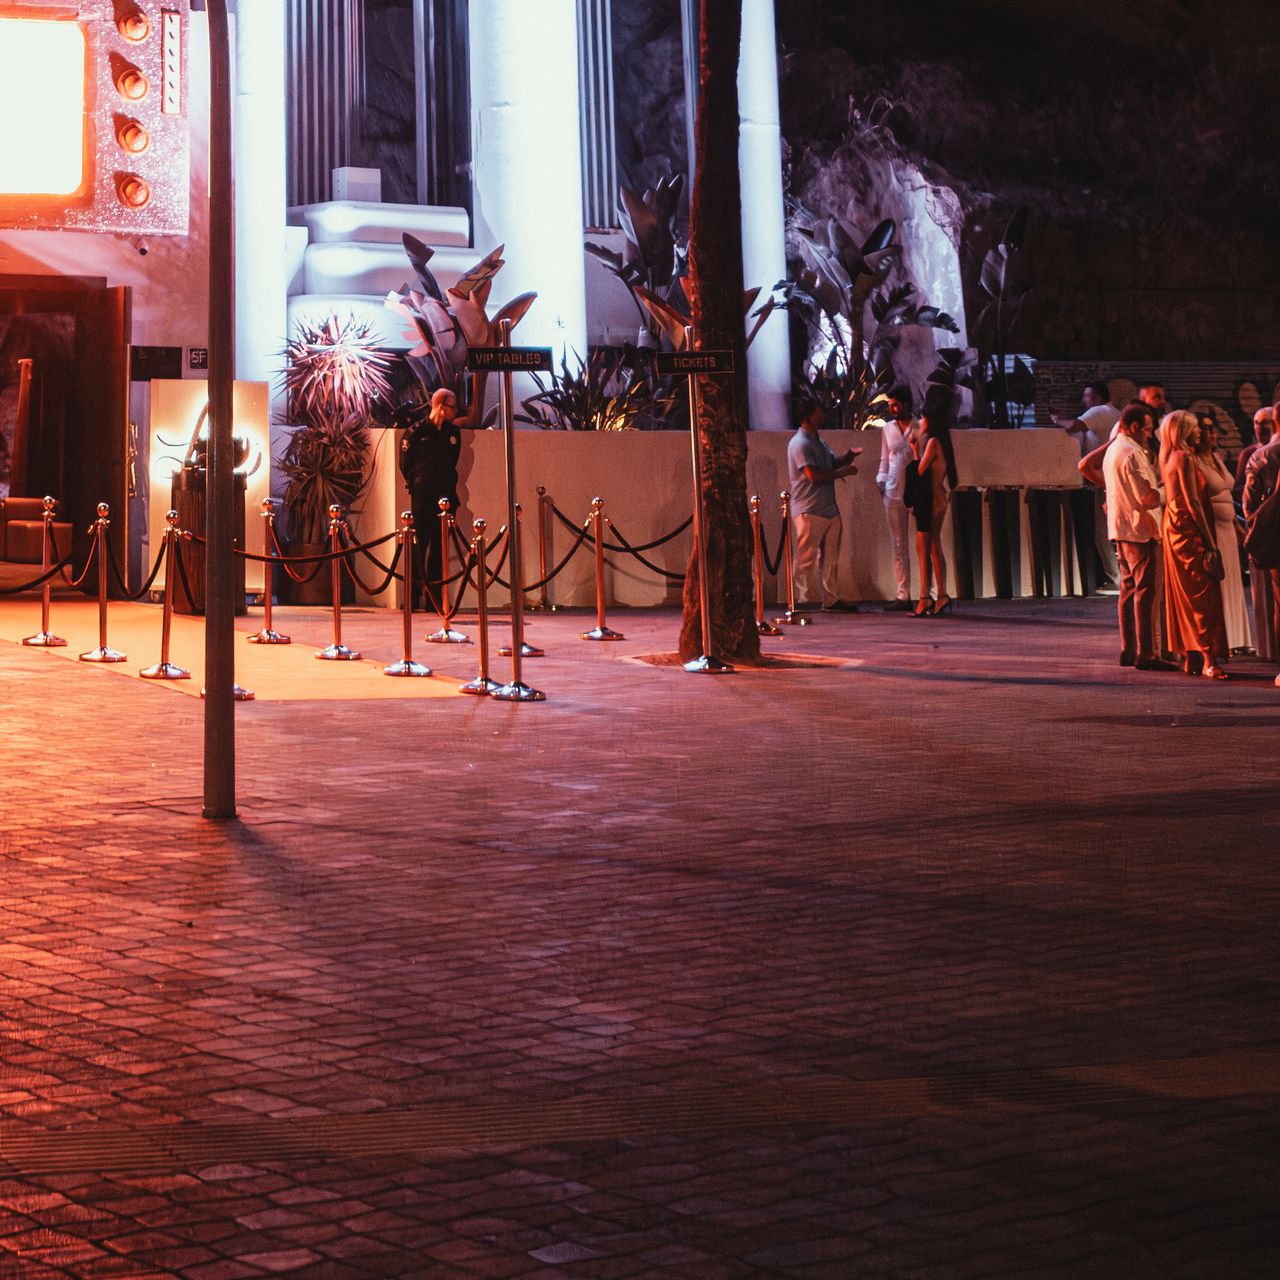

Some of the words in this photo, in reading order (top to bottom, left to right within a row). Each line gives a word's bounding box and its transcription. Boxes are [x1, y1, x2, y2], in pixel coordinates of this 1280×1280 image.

[475, 352, 494, 365] VIP
[497, 352, 542, 365] TABLES
[672, 356, 717, 369] TICKETS
